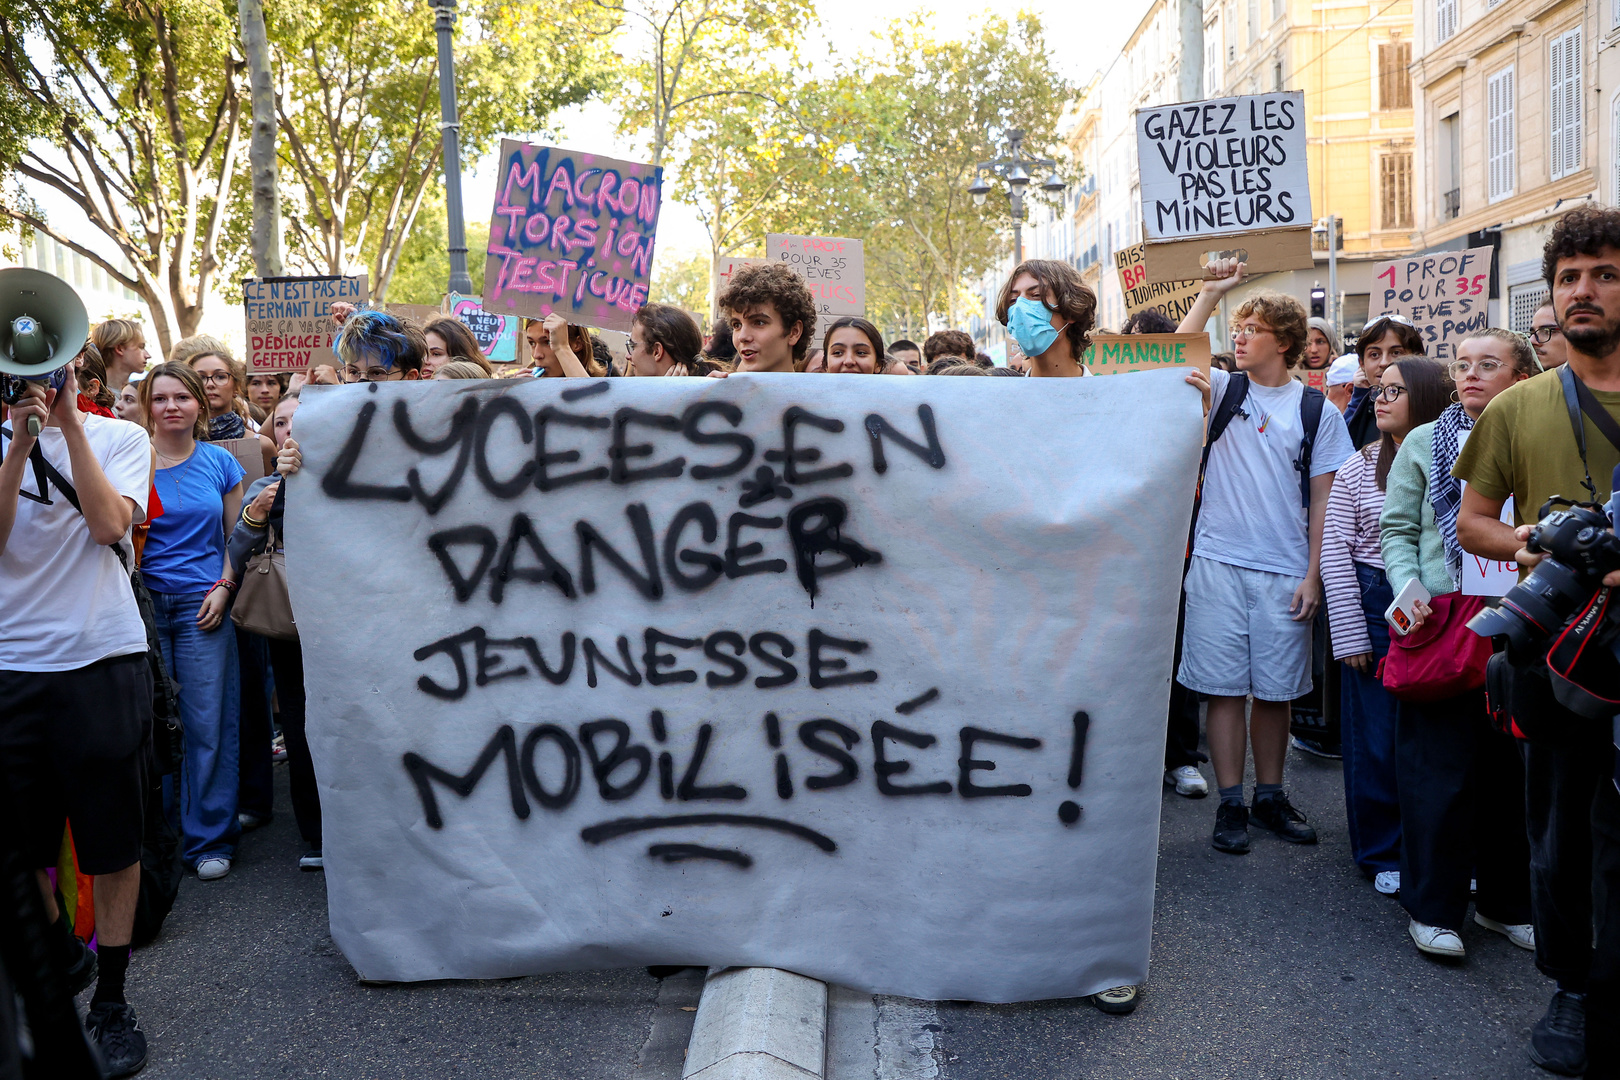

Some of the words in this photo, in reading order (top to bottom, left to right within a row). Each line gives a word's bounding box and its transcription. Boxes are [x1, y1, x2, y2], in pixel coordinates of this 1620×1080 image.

[1144, 103, 1236, 140] GAZEZ
[1250, 100, 1295, 131] LES
[501, 158, 659, 225] MACRON
[1178, 170, 1226, 200] PAS
[1231, 167, 1271, 195] LES
[781, 251, 822, 266] POUR
[831, 257, 847, 268] 35
[802, 238, 846, 254] PROF
[1377, 265, 1396, 288] 1
[1407, 254, 1475, 284] PROF
[245, 281, 265, 300] CE
[271, 281, 310, 300] N'EST
[312, 280, 336, 298] PAS
[339, 280, 360, 297] EN
[1384, 279, 1446, 308] POUR
[1455, 274, 1487, 296] 35
[247, 301, 311, 319] FERMANT
[248, 320, 273, 334] QUE
[277, 320, 294, 337] ÇA
[300, 320, 314, 333] VA
[1443, 311, 1486, 341] POUR
[252, 350, 311, 367] GEFFRAY
[1101, 342, 1186, 365] MANQUE
[321, 382, 756, 516] LYCÉES
[764, 403, 947, 486] EN
[428, 496, 884, 609] DANGER
[1580, 605, 1598, 625] Mark
[413, 626, 878, 700] JEUNESSE
[1056, 710, 1091, 827] !
